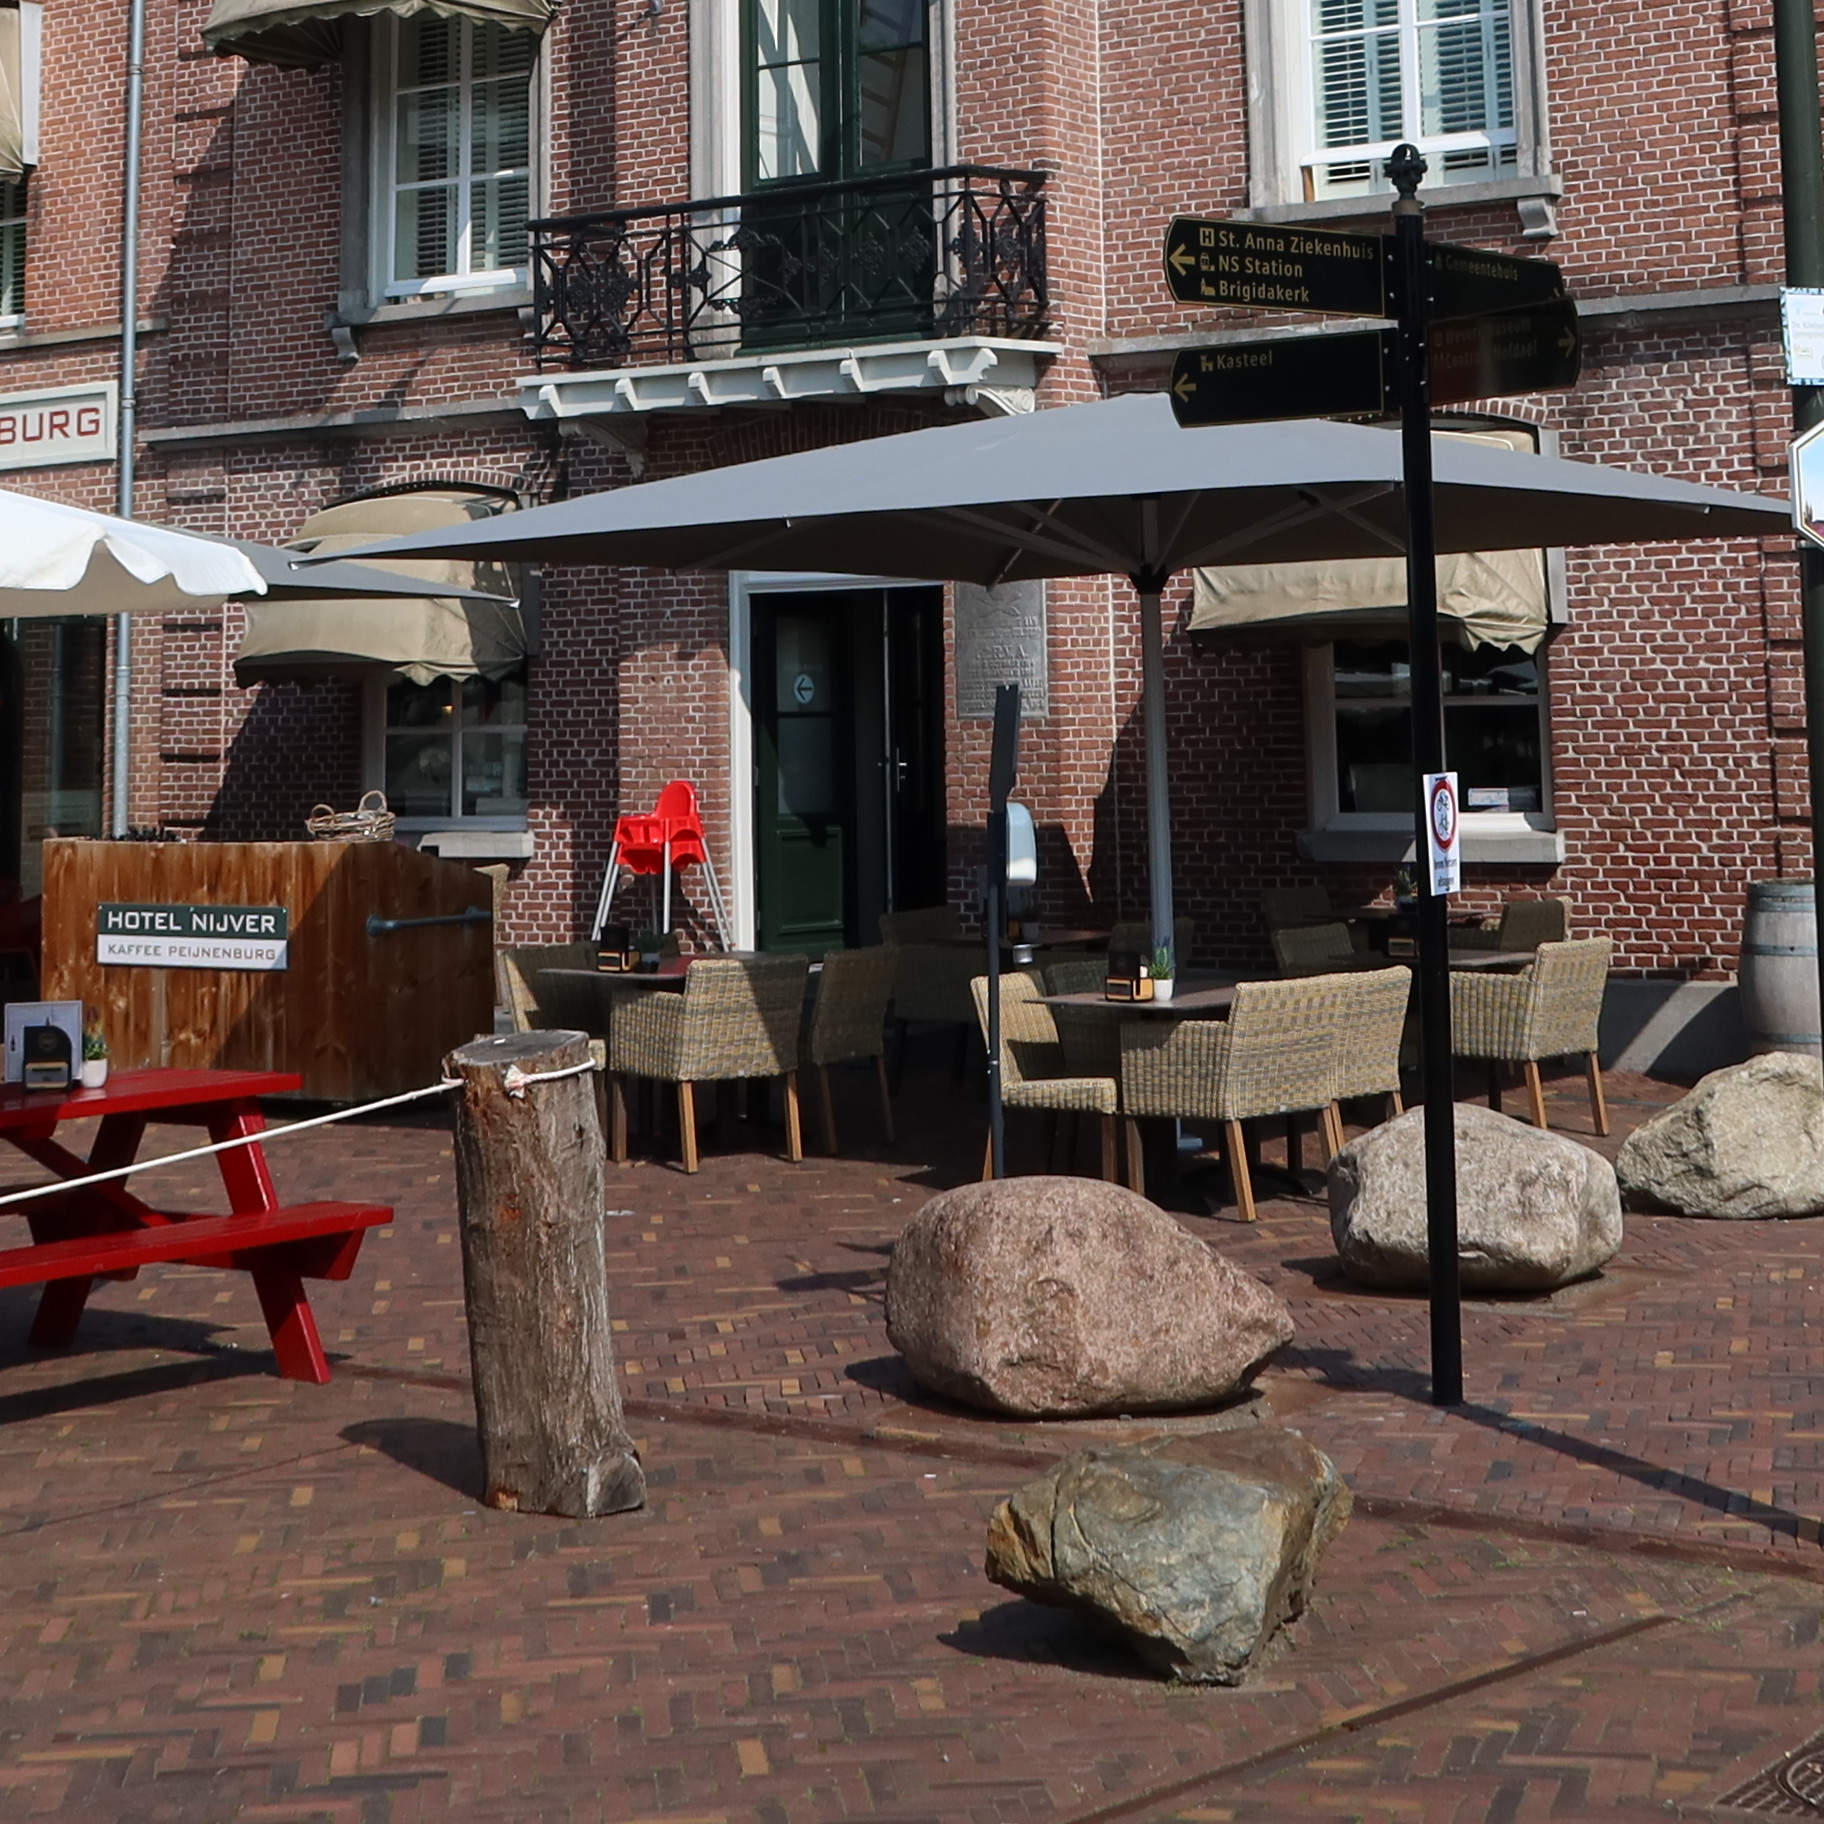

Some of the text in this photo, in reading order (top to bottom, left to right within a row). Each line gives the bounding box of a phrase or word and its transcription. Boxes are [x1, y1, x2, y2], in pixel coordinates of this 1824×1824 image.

[1218, 230, 1240, 249] St.
[1245, 233, 1285, 252] Anna
[1290, 236, 1375, 261] Ziekenhuis
[1218, 255, 1303, 277] NS Station
[1445, 254, 1519, 281] Gemeentehuis
[1219, 280, 1310, 303] Brigidakerk
[1217, 349, 1274, 370] Kasteel
[107, 910, 276, 934] HOTEL NIJVER
[107, 943, 276, 960] KAFFEE PEIJNENBURG
